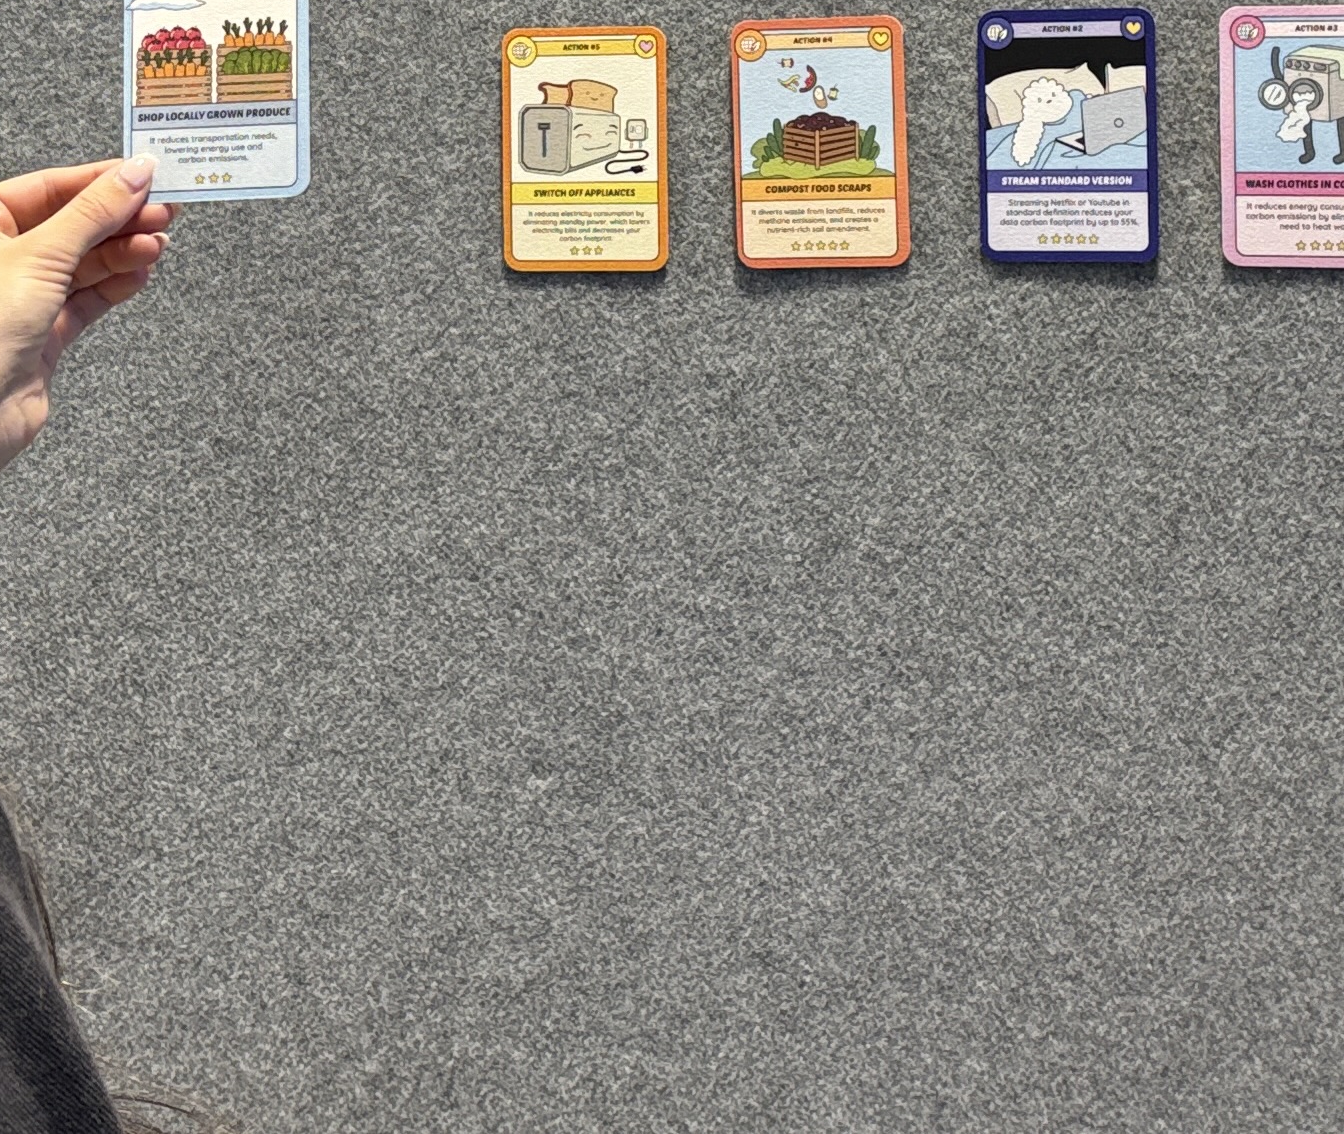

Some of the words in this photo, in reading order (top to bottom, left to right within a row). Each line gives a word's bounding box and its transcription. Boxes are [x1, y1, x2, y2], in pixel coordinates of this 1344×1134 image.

[793, 37, 821, 45] ACTION
[138, 114, 163, 122] SHOP
[166, 111, 205, 121] LOCALLY
[207, 110, 243, 119] GROWN
[246, 107, 291, 117] PRODUCE
[1002, 177, 1039, 185] STREAM
[1041, 176, 1090, 185] STANDARD
[1092, 176, 1132, 185] VERSION
[1246, 180, 1274, 188] WASH
[1277, 180, 1318, 188] CLOTHES
[1321, 180, 1331, 188] IN
[534, 189, 566, 197] SWITCH
[569, 189, 583, 197] OFF
[585, 189, 635, 197] APPLIANCES
[765, 185, 809, 194] COMPOST
[811, 185, 835, 193] FOOD
[838, 184, 871, 192] SCRAPS
